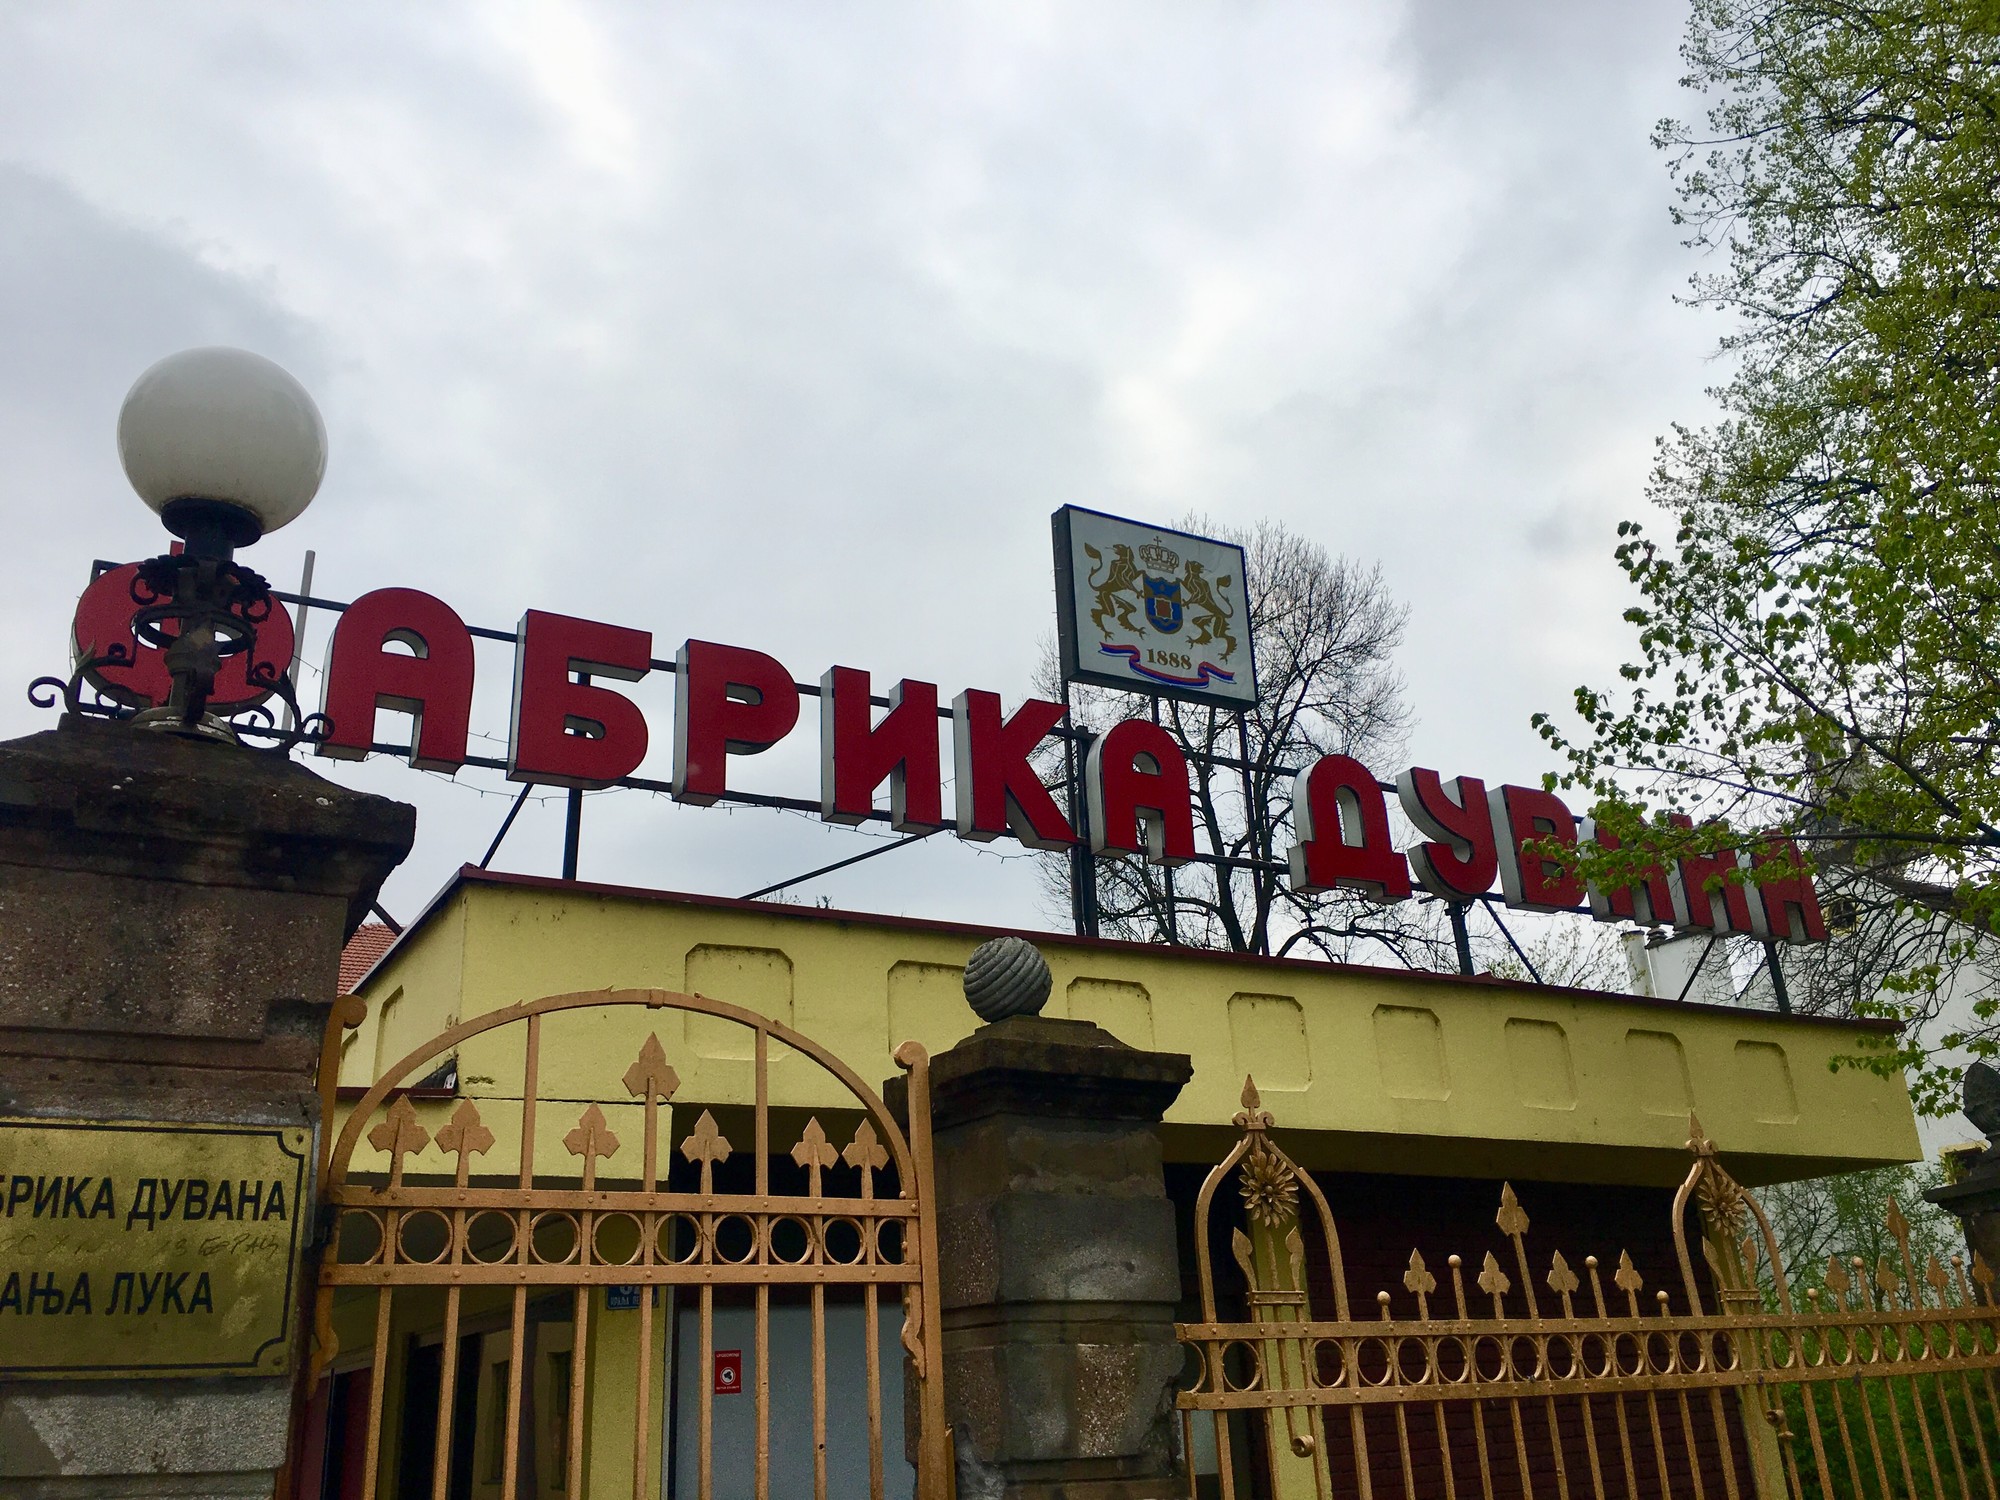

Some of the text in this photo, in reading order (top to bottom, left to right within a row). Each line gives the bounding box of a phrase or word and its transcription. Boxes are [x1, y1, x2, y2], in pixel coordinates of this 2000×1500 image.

[1146, 648, 1192, 670] 1888
[0, 1174, 288, 1231] РИКА ДУВАНА
[105, 1271, 214, 1315] ЛУКА
